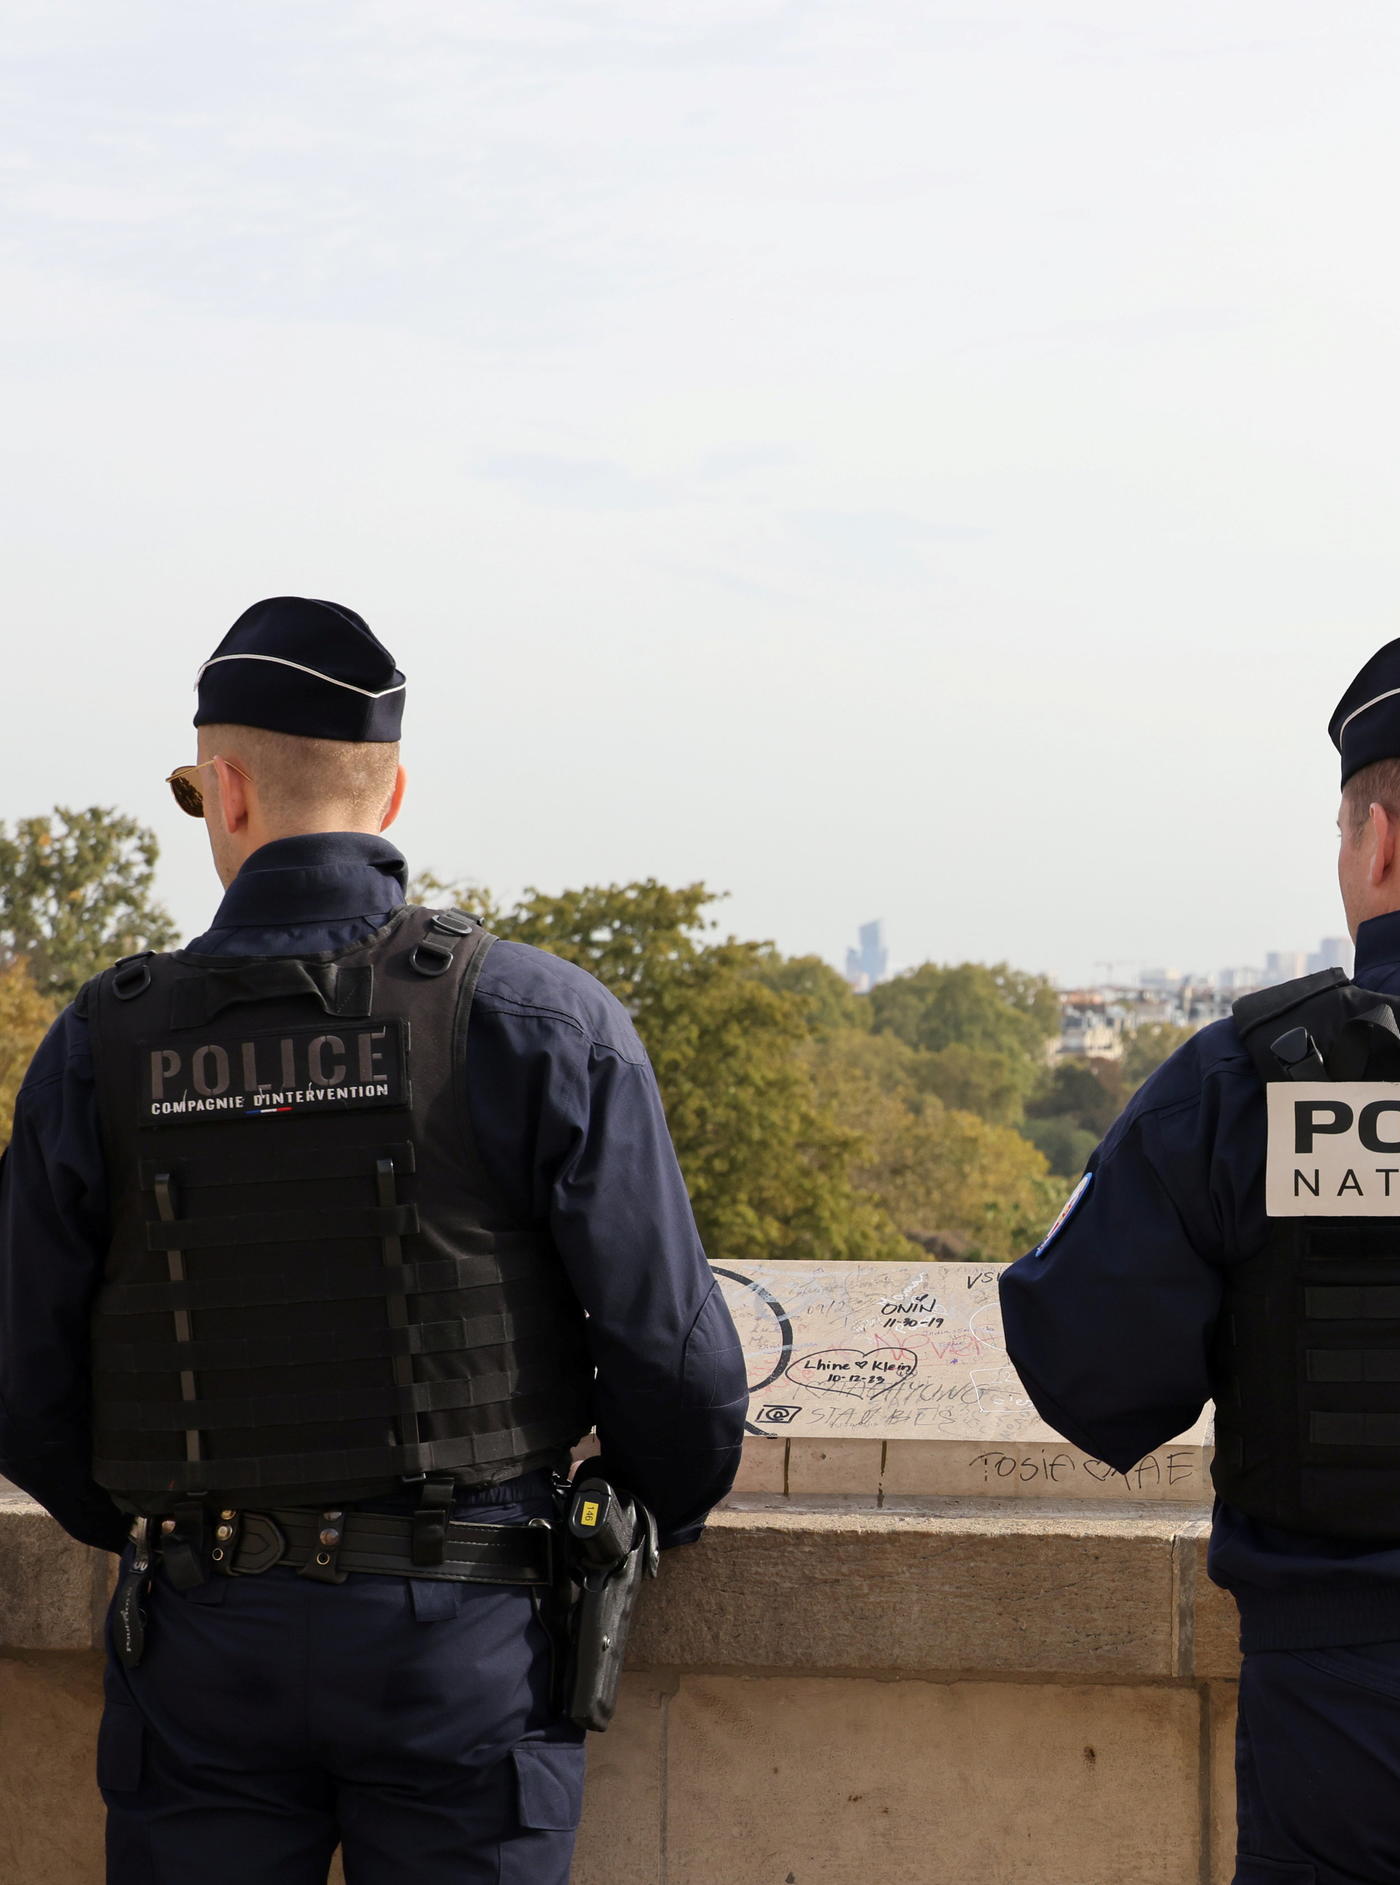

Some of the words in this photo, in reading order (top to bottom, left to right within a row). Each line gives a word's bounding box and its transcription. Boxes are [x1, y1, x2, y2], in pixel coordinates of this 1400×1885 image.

[151, 1031, 388, 1100] POLICE
[151, 1096, 244, 1115] COMPAGNIE
[871, 1359, 912, 1373] Klein
[585, 1506, 595, 1522] 146
